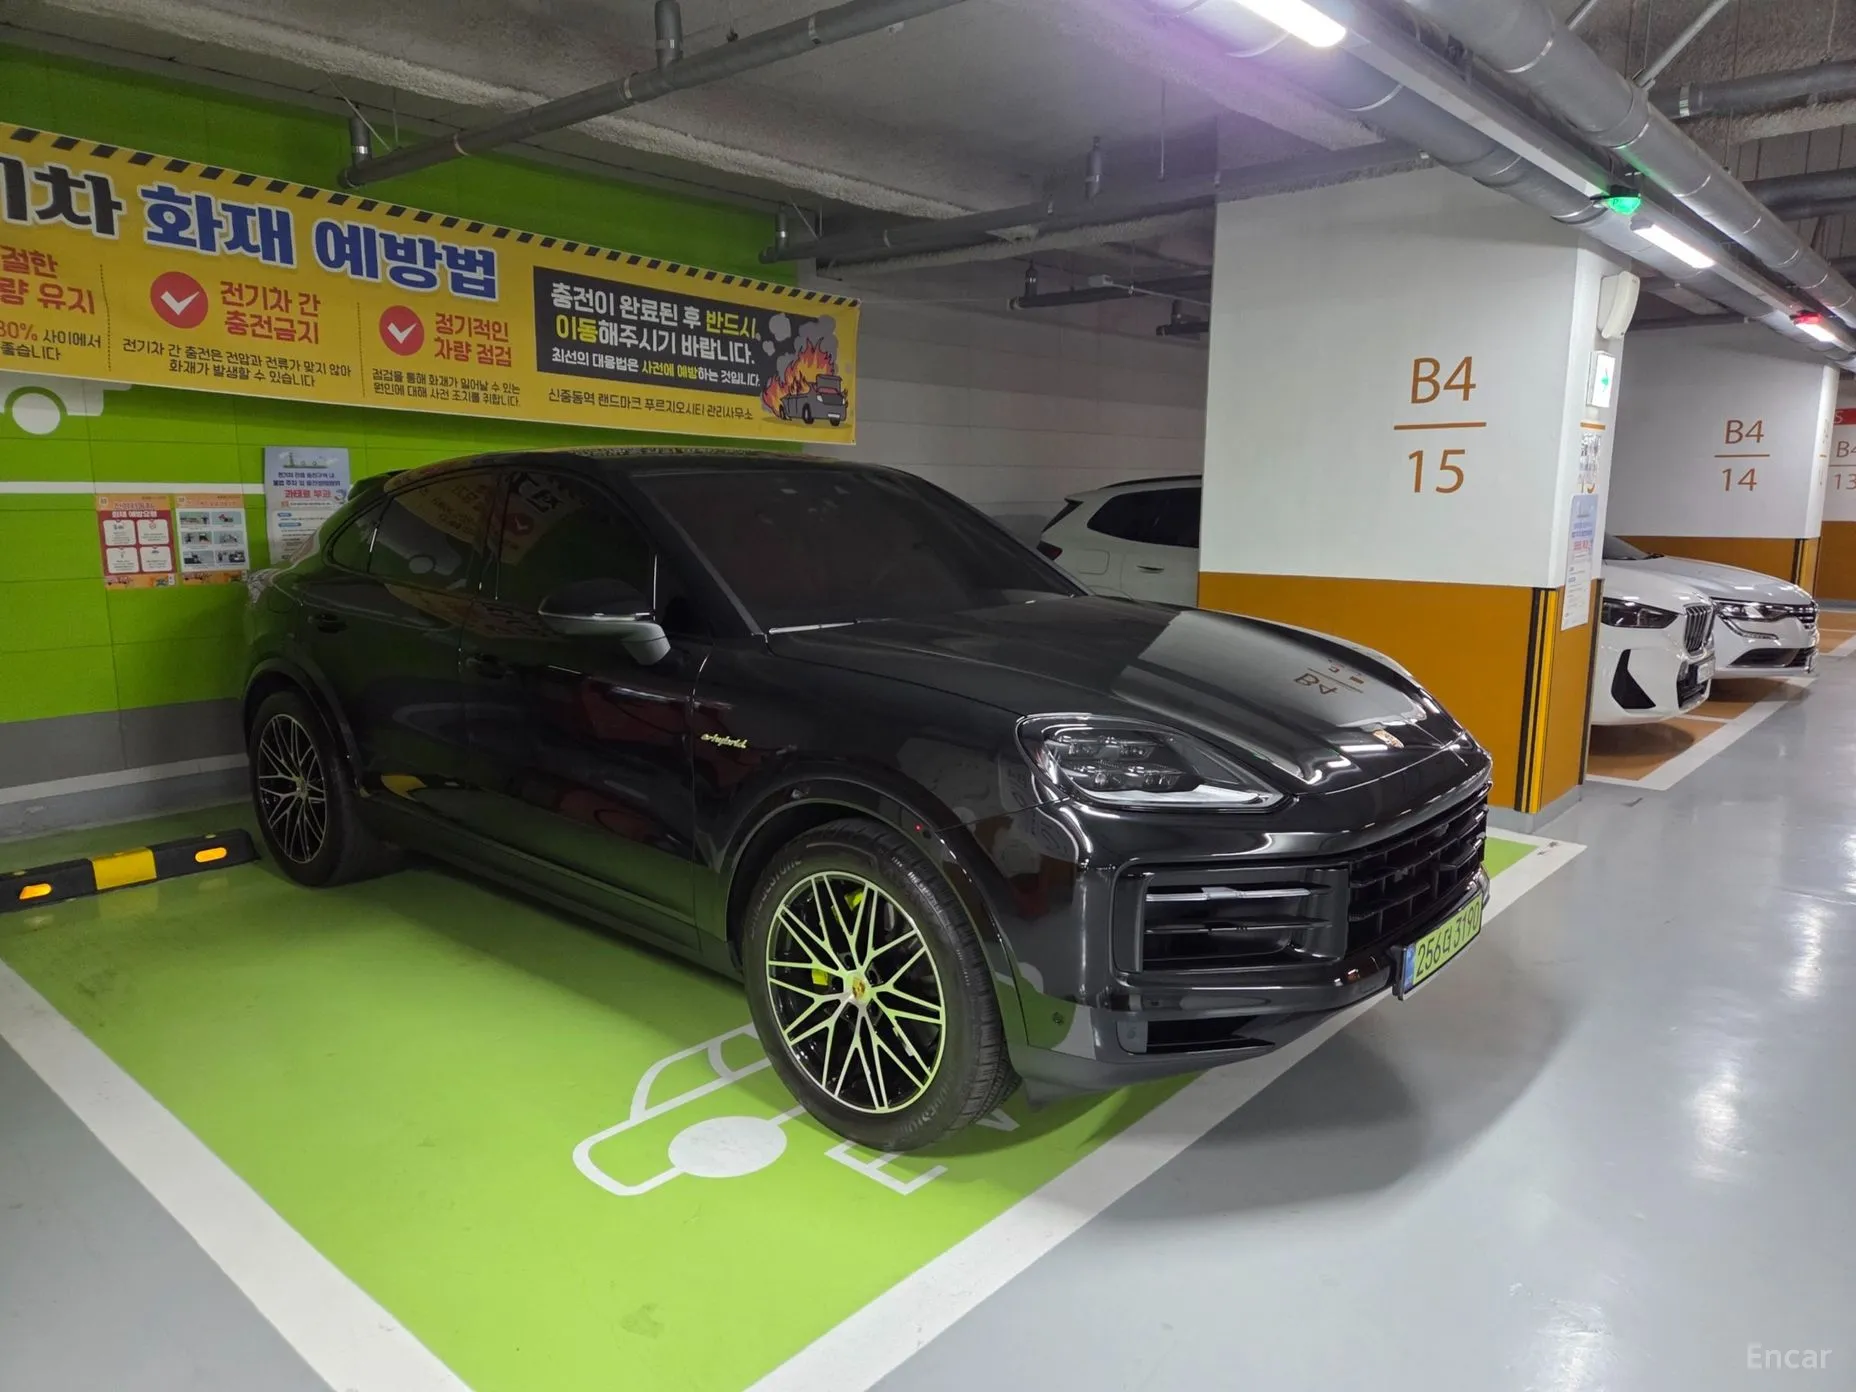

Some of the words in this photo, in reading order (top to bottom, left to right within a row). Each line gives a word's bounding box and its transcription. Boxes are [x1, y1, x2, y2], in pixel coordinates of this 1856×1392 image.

[140, 184, 295, 266] 화재
[314, 220, 497, 300] 예방법
[37, 282, 95, 315] 유지
[220, 280, 293, 313] 전기차
[297, 291, 321, 318] 간
[551, 281, 615, 317] 충전이
[619, 294, 678, 327] 완료된
[683, 305, 702, 329] 후
[43, 328, 101, 349] 사이에서
[224, 309, 319, 345] 충전금지
[435, 311, 509, 343] 정기적인
[555, 313, 676, 354] 이동해주시기
[681, 334, 756, 365] 바랍니다.
[1, 341, 62, 361] 좋습니다
[122, 338, 165, 356] 전기차
[168, 343, 182, 357] 간
[185, 345, 223, 363] 충전은
[227, 351, 262, 368] 전압과
[266, 356, 301, 372] 전류가
[303, 360, 327, 375] 맞지
[329, 362, 352, 378] 않아
[434, 336, 472, 362] 차량
[476, 343, 512, 368] 점검
[552, 346, 589, 366] 최선의
[641, 359, 675, 377] 사전에
[677, 363, 719, 383] 예방하는
[169, 358, 210, 376] 화재가
[213, 363, 251, 381] 발생할
[253, 371, 267, 383] 수
[269, 371, 316, 388] 있습니다
[372, 367, 403, 382] 점검을
[406, 371, 426, 385] 통해
[428, 374, 458, 389] 화재가
[460, 378, 489, 392] 일어날
[491, 383, 501, 393] 수
[502, 382, 521, 395] 있는
[1410, 355, 1477, 404] B4
[374, 382, 405, 397] 원인에
[407, 385, 428, 398] 대해
[430, 388, 449, 401] 사전
[548, 387, 595, 406] 신중동역
[597, 392, 642, 411] 랜드마크
[644, 397, 705, 416] 푸르지오시티
[706, 405, 754, 421] 관리사무소
[1725, 419, 1765, 444] B4
[1408, 448, 1466, 494] 15
[1722, 468, 1758, 491] 14
